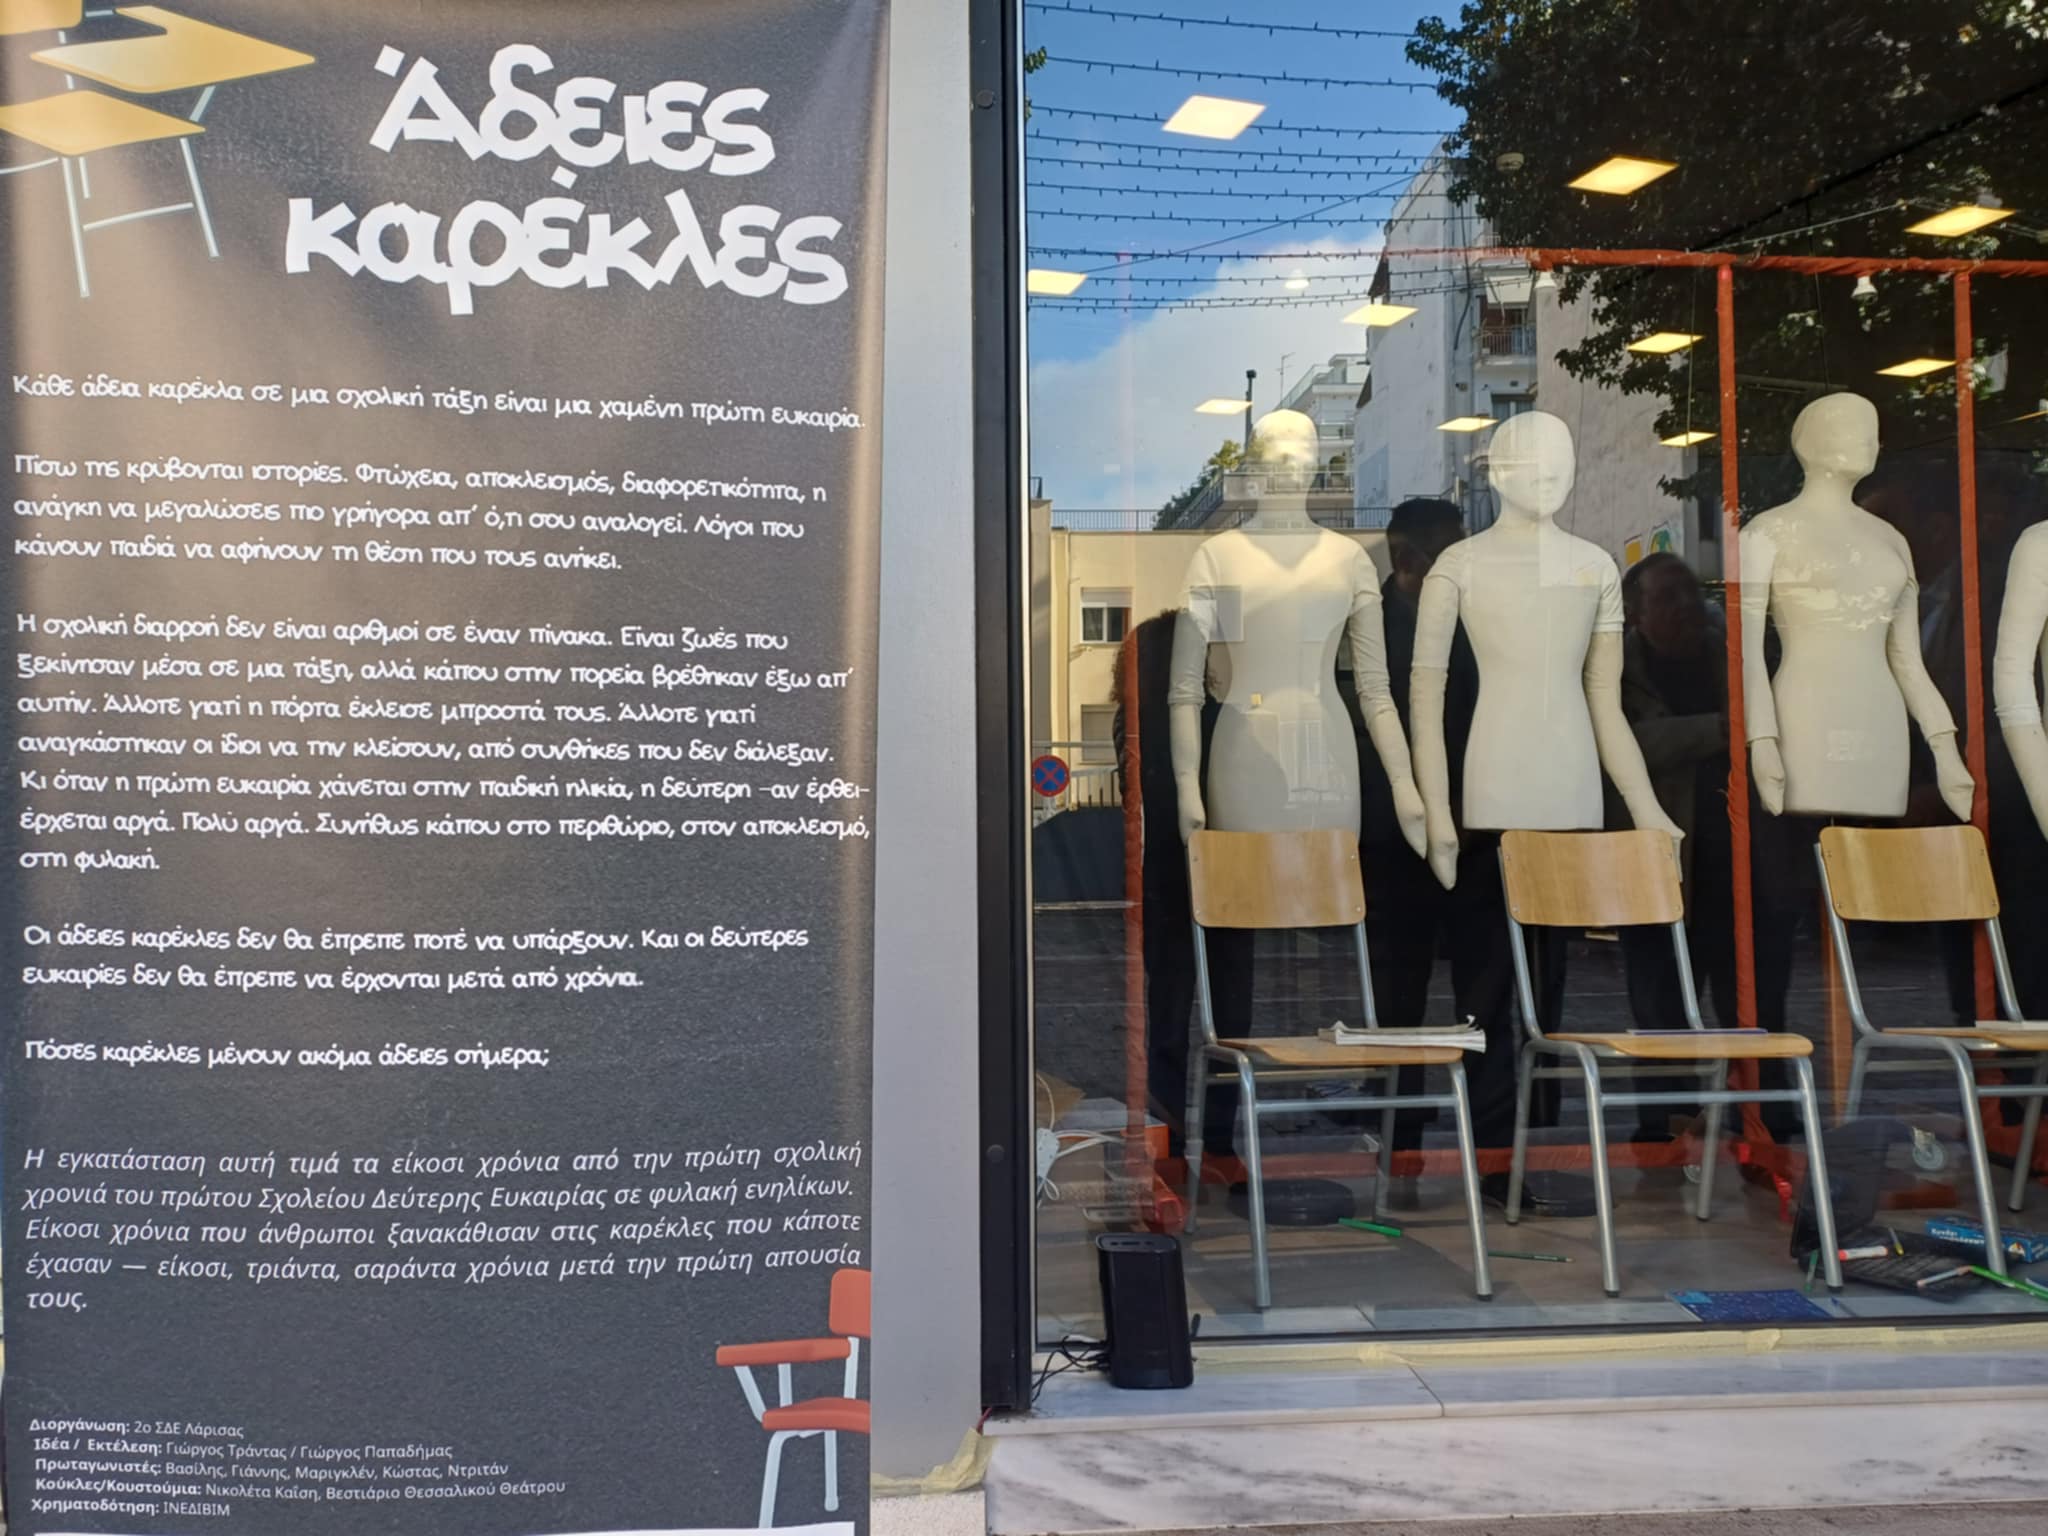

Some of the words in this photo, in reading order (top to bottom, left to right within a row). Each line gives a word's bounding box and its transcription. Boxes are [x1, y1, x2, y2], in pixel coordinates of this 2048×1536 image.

[369, 43, 776, 178] Άδειες
[285, 167, 849, 315] καρέκλες
[12, 373, 75, 397] Κάθε
[81, 373, 142, 398] άδεια
[148, 376, 244, 404] καρέκλα
[251, 384, 283, 402] σε
[291, 387, 330, 408] μια
[336, 384, 425, 409] σχολική
[431, 386, 488, 415] τάξη
[494, 389, 548, 413] είναι
[554, 397, 593, 419] μια
[598, 394, 684, 422] χαμένη
[690, 399, 766, 426] πρώτη
[771, 406, 866, 433] ευκαιρία.
[14, 454, 77, 477] Πίσω
[84, 460, 121, 478] της
[126, 456, 243, 484] κρύβονται
[251, 460, 349, 488] ιστορίες.
[355, 463, 459, 490] Φτώχεια,
[465, 469, 616, 497] αποκλεισμός,
[621, 470, 806, 505] διαφορετικότητα,
[812, 486, 827, 502] η
[14, 532, 103, 557] κάνουν
[109, 534, 177, 558] παιδιά
[183, 543, 215, 559] να
[220, 536, 324, 564] αφήνουν
[331, 545, 359, 562] τη
[364, 539, 424, 564] θέση
[430, 547, 477, 565] που
[483, 549, 538, 568] τους
[543, 545, 622, 570] ανήκει.
[16, 613, 37, 633] Η
[42, 612, 128, 639] σχολική
[133, 612, 220, 643] διαρροή
[225, 614, 266, 639] δεν
[273, 617, 327, 640] είναι
[332, 618, 419, 646] αριθμοί
[425, 624, 457, 643] σε
[463, 619, 521, 645] έναν
[528, 623, 613, 647] πίνακα.
[620, 625, 675, 648] Είναι
[681, 626, 739, 653] ζωές
[744, 633, 789, 651] που
[16, 689, 97, 715] αυτήν.
[102, 692, 182, 715] Άλλοτε
[188, 694, 241, 721] γιατί
[247, 700, 264, 716] η
[270, 694, 342, 723] πόρτα
[348, 695, 434, 720] έκλεισε
[440, 698, 547, 726] μπροστά
[553, 705, 612, 723] τους.
[617, 701, 699, 724] Άλλοτε
[704, 703, 757, 729] γιατί
[19, 806, 108, 835] έρχεται
[112, 808, 176, 837] αργά.
[182, 811, 239, 833] Πολύ
[244, 811, 310, 839] αργά.
[314, 811, 420, 836] Συνήθως
[425, 812, 501, 836] κάπου
[506, 819, 552, 836] στο
[558, 813, 676, 842] περιθώριο,
[680, 819, 738, 837] στον
[742, 815, 870, 841] αποκλεισμό,
[23, 924, 52, 946] Οι
[56, 922, 126, 947] άδειες
[131, 924, 232, 953] καρέκλες
[236, 926, 278, 951] δεν
[283, 927, 315, 951] θα
[320, 926, 406, 956] έπρεπε
[413, 927, 469, 951] ποτέ
[474, 934, 506, 952] να
[512, 927, 635, 956] υπάρξουν.
[640, 928, 680, 949] Και
[683, 931, 705, 948] οι
[709, 924, 810, 952] δεύτερες
[21, 962, 128, 990] ευκαιρίες
[132, 962, 172, 987] δεν
[177, 964, 209, 987] θα
[213, 964, 298, 993] έπρεπε
[303, 972, 335, 990] να
[340, 965, 441, 995] έρχονται
[447, 965, 506, 994] μετά
[511, 965, 559, 989] από
[563, 964, 645, 993] χρόνια.
[24, 1037, 98, 1062] Πόσες
[102, 1039, 202, 1068] καρέκλες
[207, 1040, 292, 1070] μένουν
[297, 1042, 373, 1071] ακόμα
[377, 1042, 449, 1066] άδειες
[453, 1041, 550, 1071] σήμερα;
[23, 1148, 45, 1169] Η
[57, 1147, 206, 1178] εγκατάσταση
[218, 1150, 276, 1179] αυτή
[289, 1150, 340, 1179] τιμά
[352, 1157, 380, 1174] τα
[391, 1151, 465, 1174] είκοσι
[474, 1149, 561, 1179] χρόνια
[572, 1147, 620, 1171] από
[632, 1152, 673, 1175] την
[684, 1143, 761, 1173] πρώτη
[773, 1139, 862, 1168] σχολική
[20, 1181, 108, 1211] χρονιά
[114, 1188, 154, 1206] του
[161, 1184, 252, 1213] πρώτου
[257, 1186, 366, 1214] Σχολείου
[370, 1185, 484, 1214] Δεύτερης
[490, 1183, 608, 1212] Ευκαιρίας
[614, 1187, 643, 1205] σε
[648, 1177, 738, 1209] φυλακή
[744, 1173, 853, 1204] ενηλίκων.
[25, 1216, 101, 1240] Είκοσι
[108, 1218, 190, 1246] χρόνια
[200, 1226, 247, 1243] που
[258, 1220, 376, 1250] άνθρωποι
[387, 1220, 541, 1249] ξανακάθισαν
[550, 1224, 600, 1246] στις
[609, 1215, 716, 1245] καρέκλες
[726, 1217, 773, 1236] που
[782, 1208, 862, 1232] κάποτε
[25, 1251, 113, 1280] έχασαν
[157, 1253, 233, 1281] είκοσι,
[246, 1256, 341, 1284] τριάντα,
[354, 1256, 457, 1285] σαράντα
[463, 1254, 550, 1284] χρόνια
[558, 1252, 615, 1282] μετά
[626, 1256, 667, 1280] την
[677, 1247, 753, 1278] πρώτη
[764, 1242, 861, 1268] απουσία
[26, 1291, 88, 1313] τους.
[33, 1437, 70, 1451] Ιδέα
[166, 1441, 224, 1459] Γιώργος
[228, 1443, 287, 1460] Τράντας
[300, 1445, 361, 1461] Γιώργος
[365, 1443, 453, 1460] Παπαδήμας
[155, 1422, 181, 1435] ΣΔΕ
[184, 1421, 244, 1439] Λάρισας
[448, 1461, 509, 1479] Ντριτάν
[205, 1484, 272, 1498] Νικολέτα
[326, 1486, 401, 1502] Βεστιάριο
[404, 1482, 496, 1499] Θεσσαλικού
[499, 1480, 566, 1497] Θεάτρου
